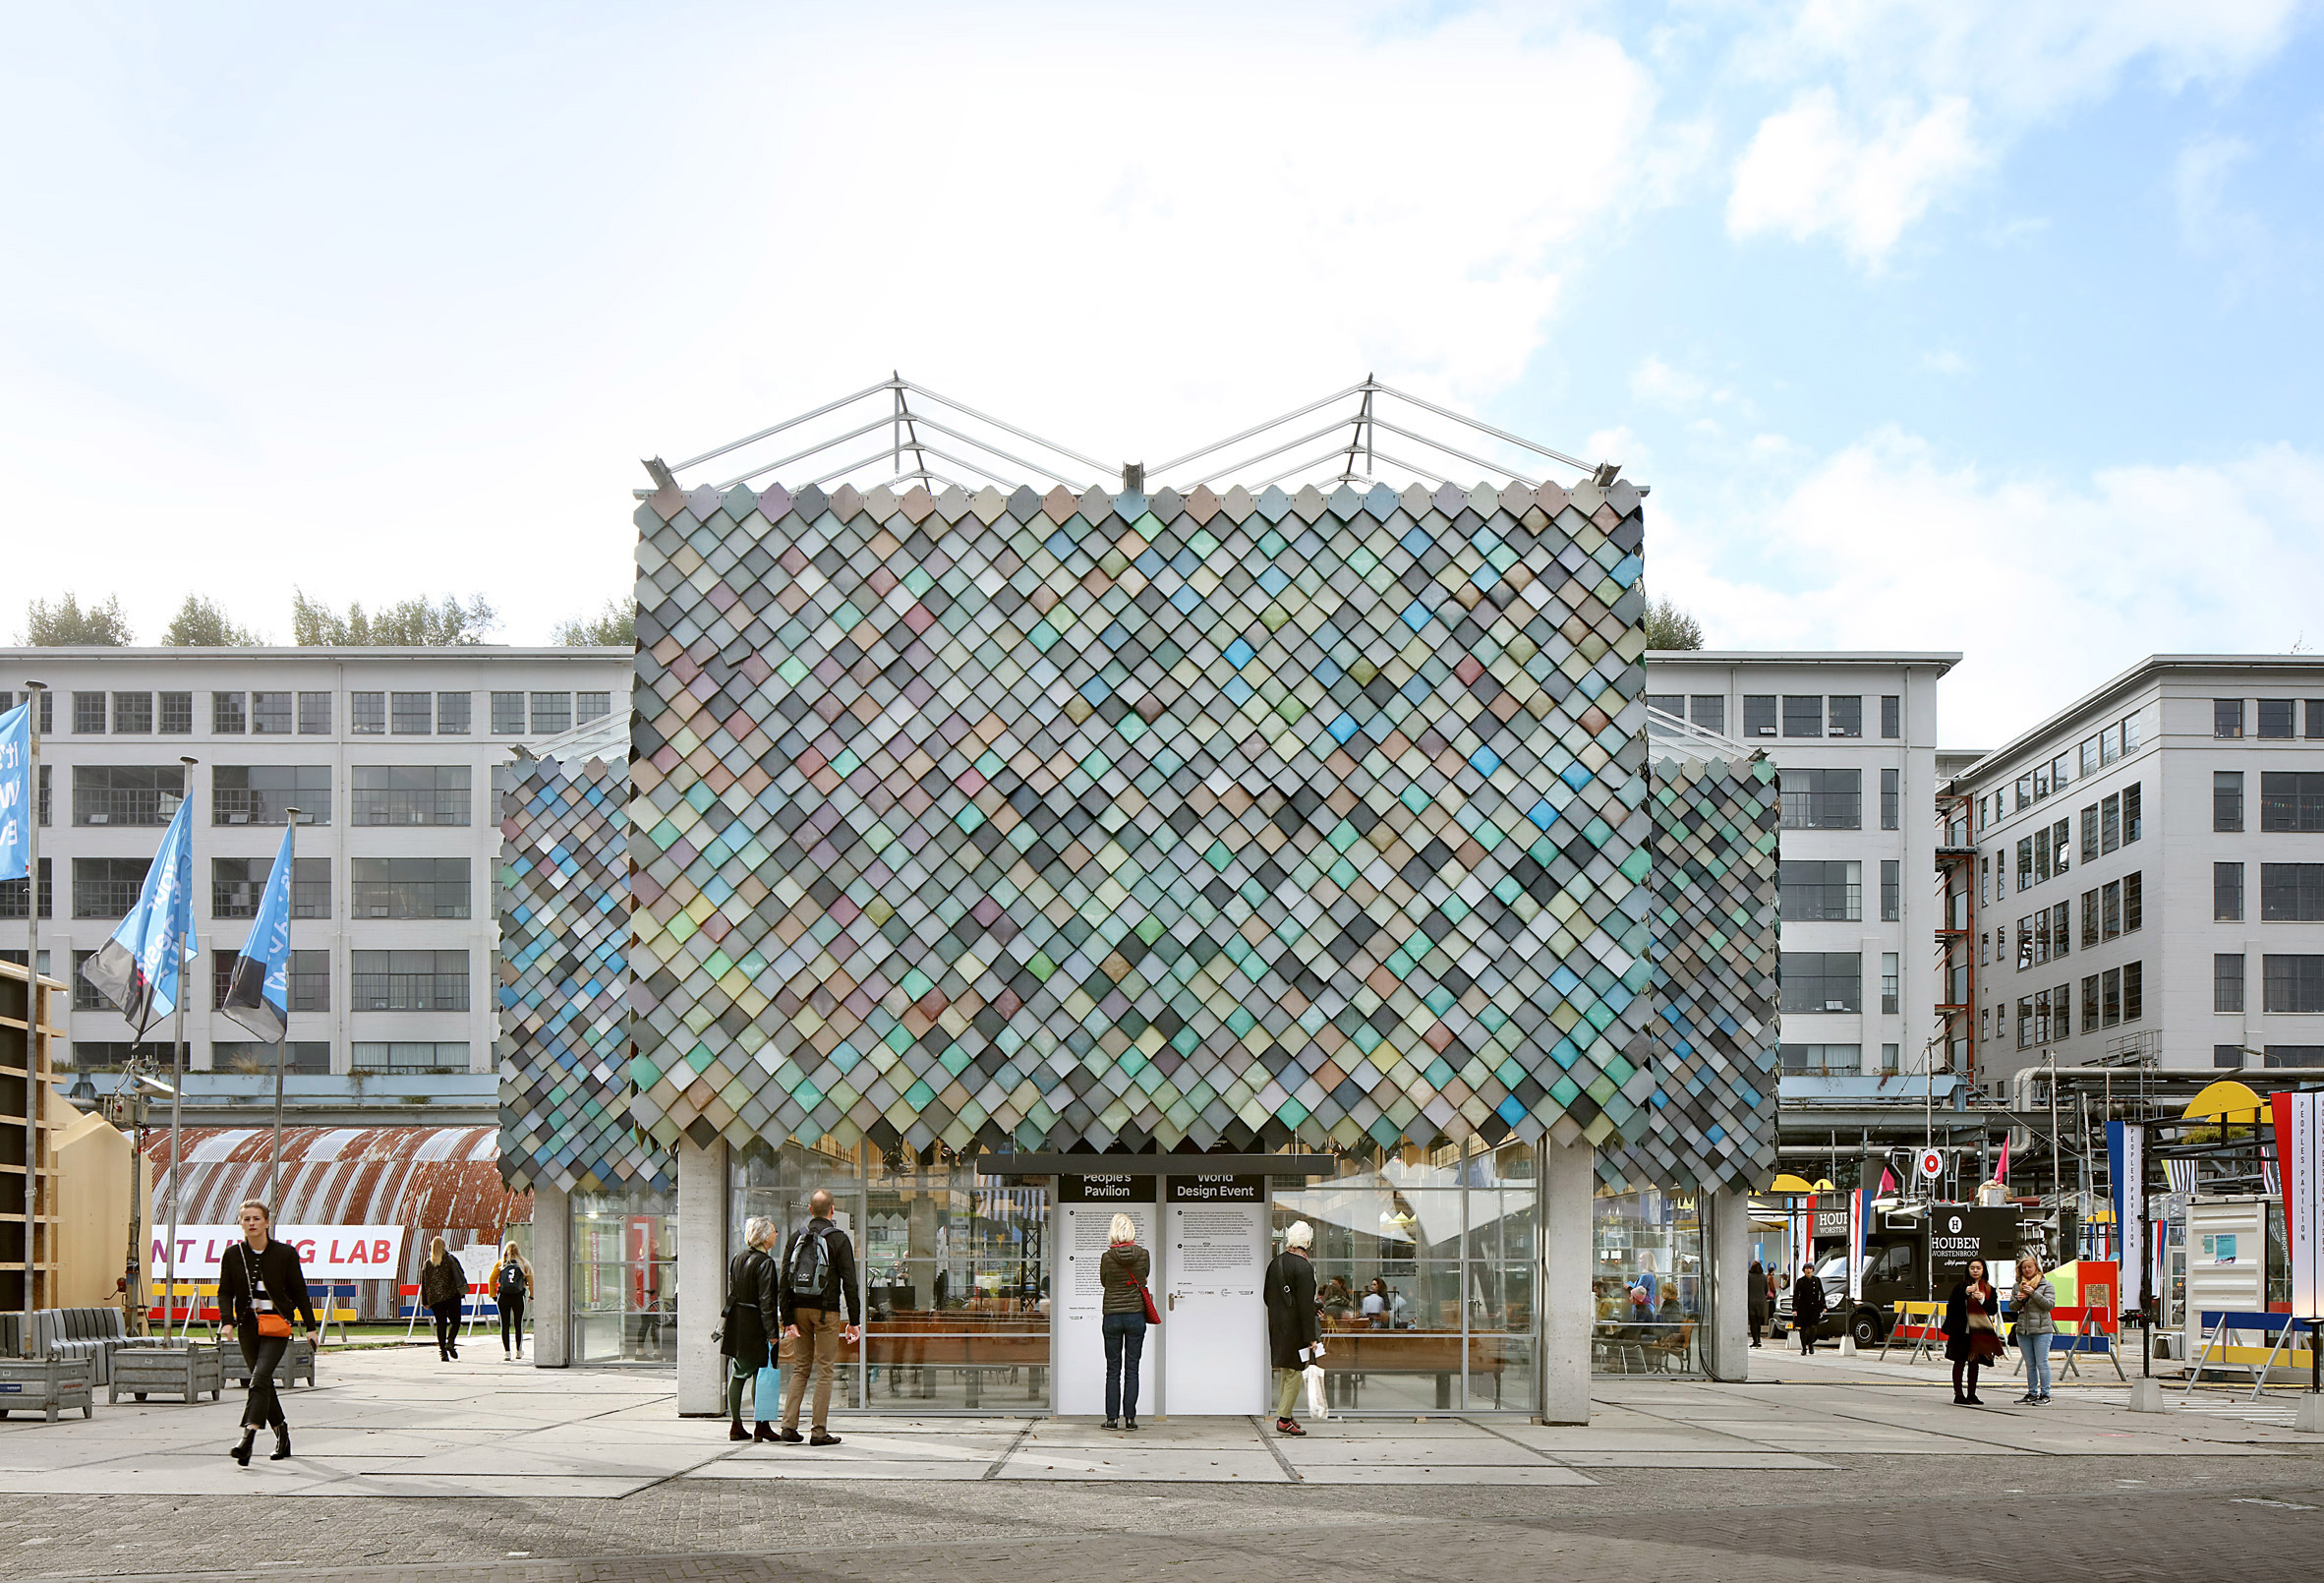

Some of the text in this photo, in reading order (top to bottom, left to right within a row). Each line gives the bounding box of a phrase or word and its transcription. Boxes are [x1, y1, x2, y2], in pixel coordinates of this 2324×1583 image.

[1083, 1174, 1132, 1185] Peoples
[1084, 1184, 1131, 1197] Pavilion
[1177, 1184, 1254, 1199] Design Event
[1932, 1237, 1980, 1249] HOUBEN
[329, 1239, 390, 1263] LAB
